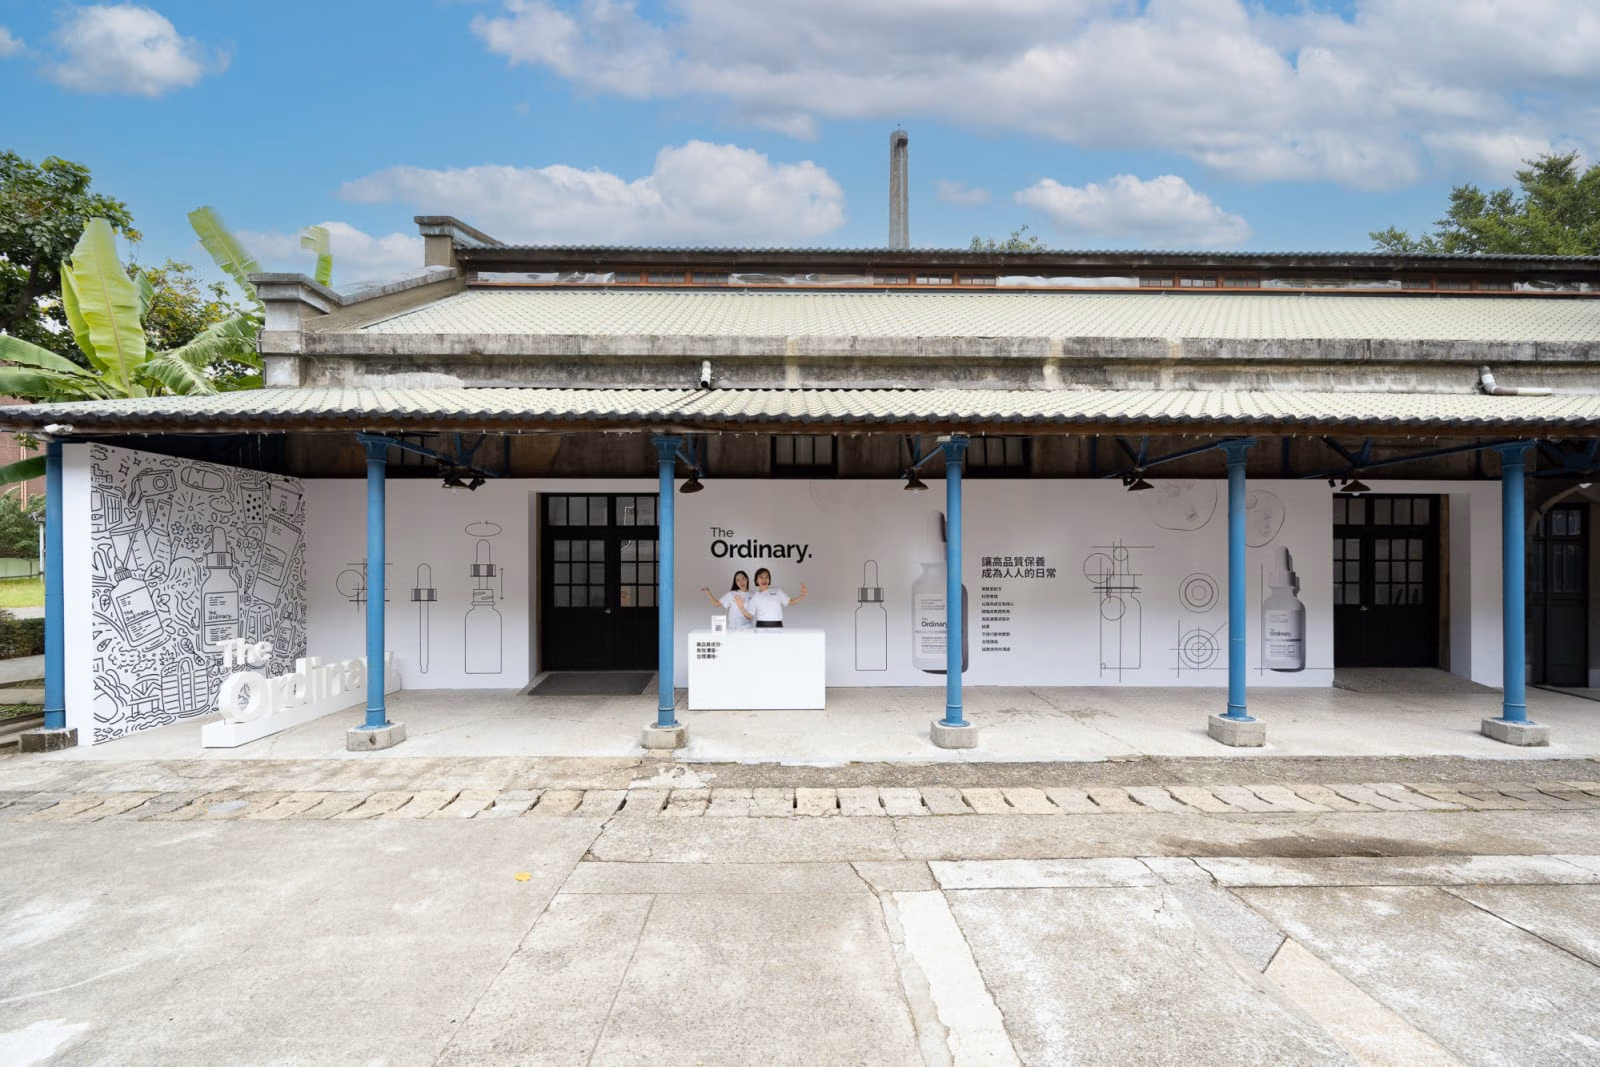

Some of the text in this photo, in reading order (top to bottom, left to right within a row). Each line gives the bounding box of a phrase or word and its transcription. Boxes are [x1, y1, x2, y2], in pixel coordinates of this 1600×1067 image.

[710, 526, 734, 538] The
[710, 539, 812, 564] Ordinary.
[981, 556, 1045, 568] 讓高品質保養
[981, 568, 1057, 579] 成為人人的日常
[216, 638, 273, 668] The
[219, 650, 396, 722] Ordina
